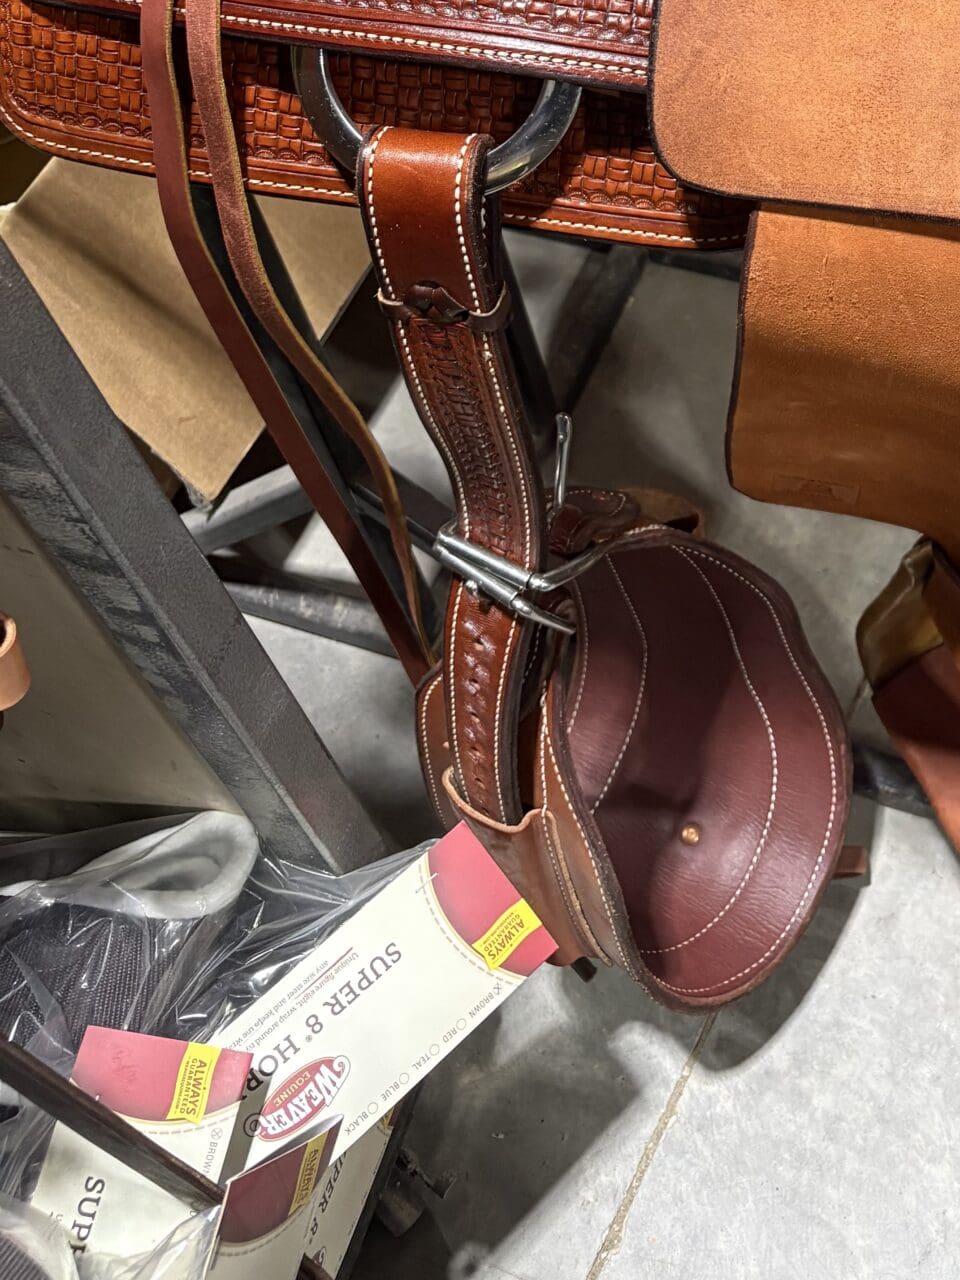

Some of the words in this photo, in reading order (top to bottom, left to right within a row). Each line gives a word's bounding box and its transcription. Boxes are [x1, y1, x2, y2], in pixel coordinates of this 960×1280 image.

[482, 912, 521, 952] GUARANTEED
[486, 918, 525, 961] ALWAYS
[331, 950, 360, 976] Unique
[301, 971, 317, 986] size
[312, 971, 336, 993] figure
[323, 942, 402, 1015] SUPER
[271, 996, 288, 1013] and
[276, 1005, 297, 1024] wrap
[467, 991, 495, 1018] BROWN
[253, 1020, 281, 1047] around
[440, 1025, 458, 1044] RED
[238, 1033, 302, 1102] HOR
[410, 1052, 431, 1071] TEAL
[178, 1057, 197, 1114] GUARANTEED
[184, 1058, 207, 1115] ALWAYS
[243, 1055, 351, 1138] WEAVER
[271, 1070, 311, 1107] EQUINE
[379, 1080, 400, 1102] BLUE
[343, 1110, 369, 1135] BLACK
